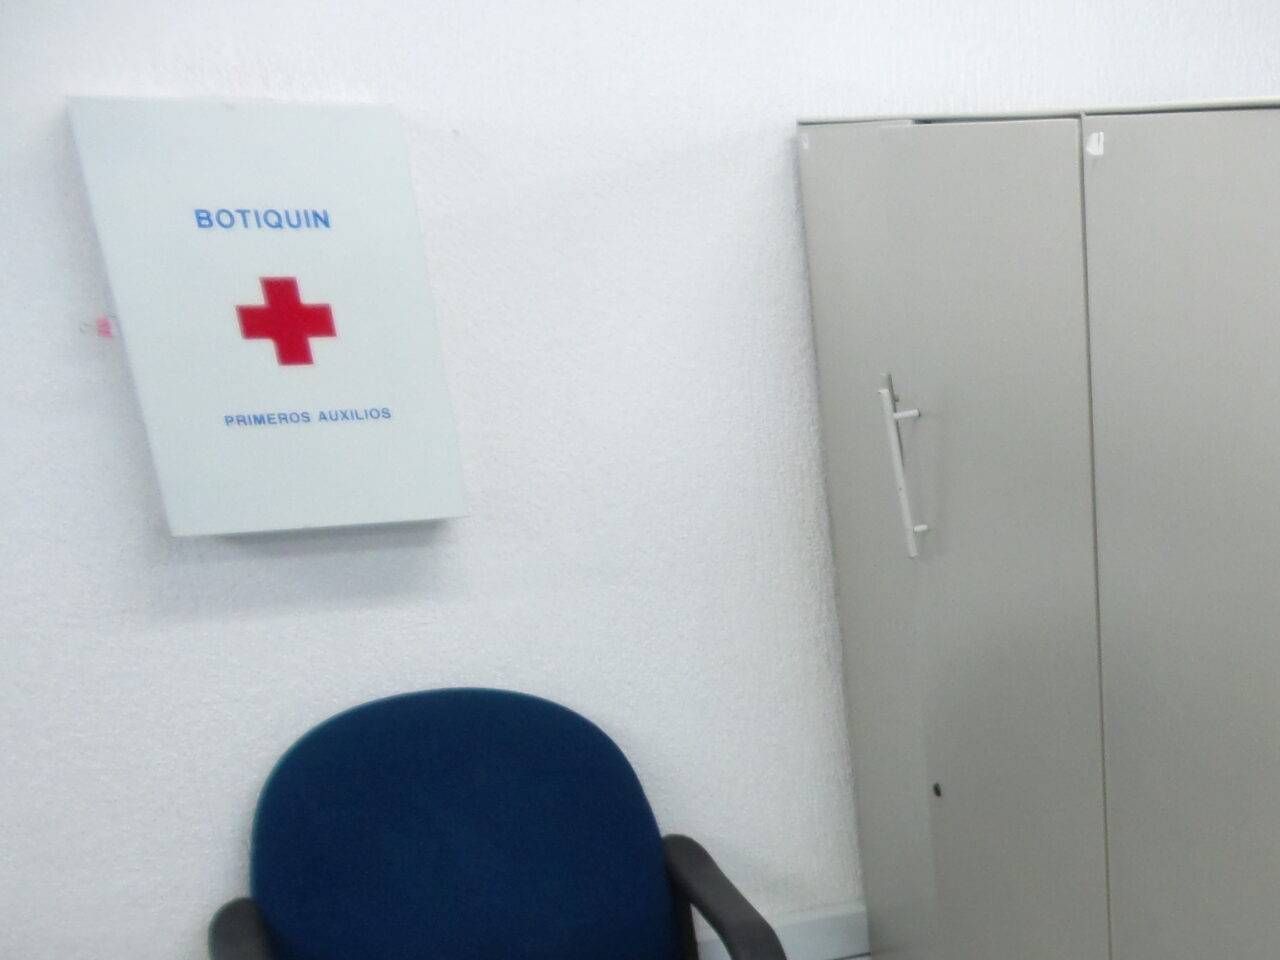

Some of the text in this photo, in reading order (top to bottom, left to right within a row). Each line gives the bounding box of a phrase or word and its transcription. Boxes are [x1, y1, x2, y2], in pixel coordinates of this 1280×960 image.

[194, 208, 332, 230] BOTIQUIN
[224, 407, 393, 428] PRIMEROS AUXILIOS
